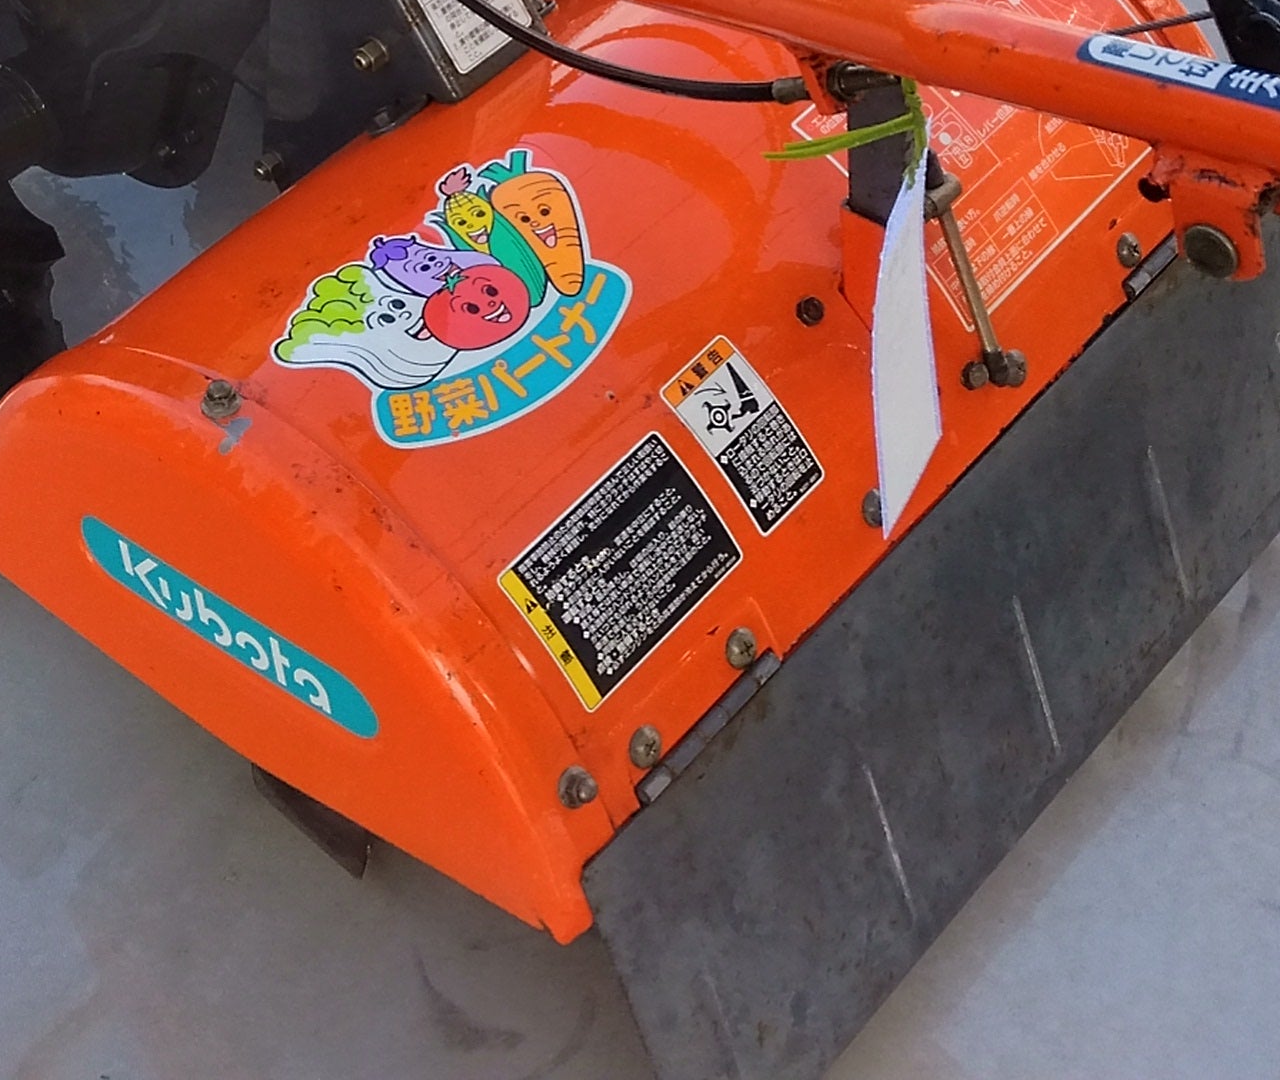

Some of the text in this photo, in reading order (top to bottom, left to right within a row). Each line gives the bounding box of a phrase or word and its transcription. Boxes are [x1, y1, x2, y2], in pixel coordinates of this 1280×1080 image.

[388, 273, 607, 437] 野菜パートナー
[118, 539, 332, 715] Kubota
